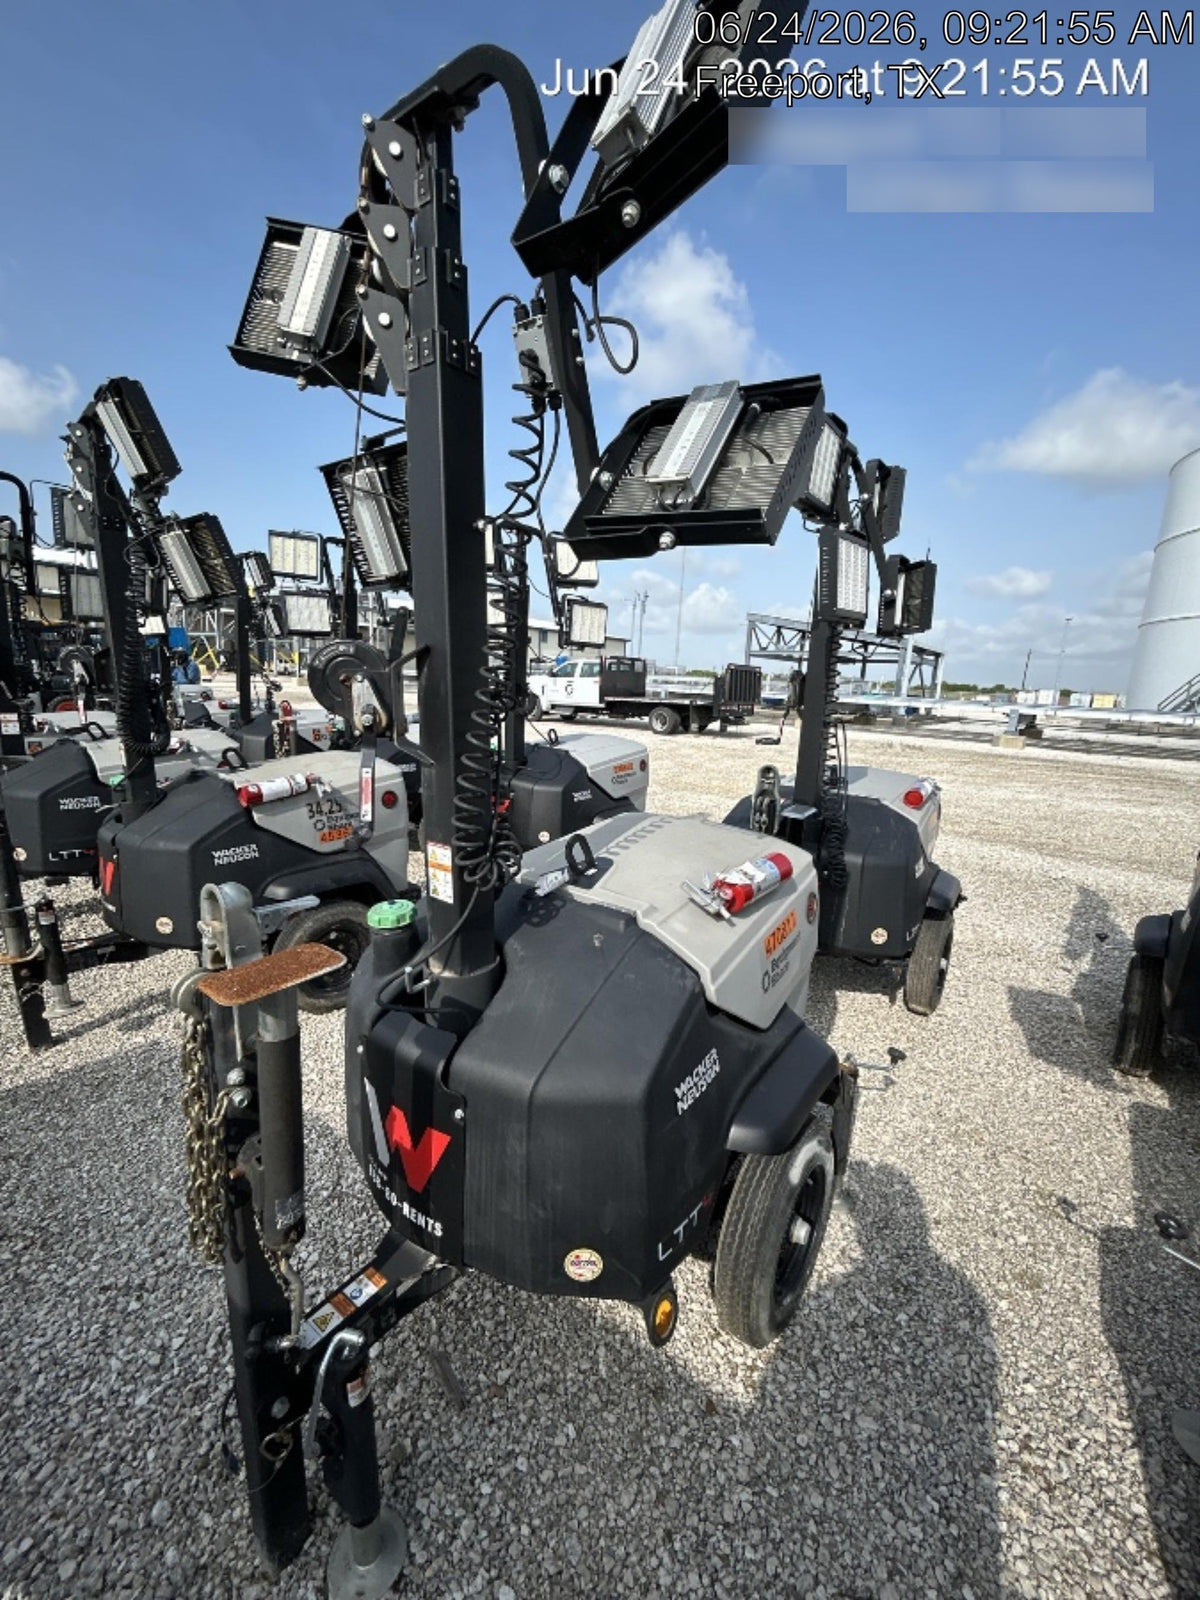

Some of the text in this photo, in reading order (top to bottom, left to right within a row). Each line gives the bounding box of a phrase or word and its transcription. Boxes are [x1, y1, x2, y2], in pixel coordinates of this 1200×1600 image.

[211, 843, 258, 858] WACKER
[214, 851, 260, 866] NEUSON
[674, 1047, 719, 1099] WACKER
[676, 1058, 720, 1116] NEUSON
